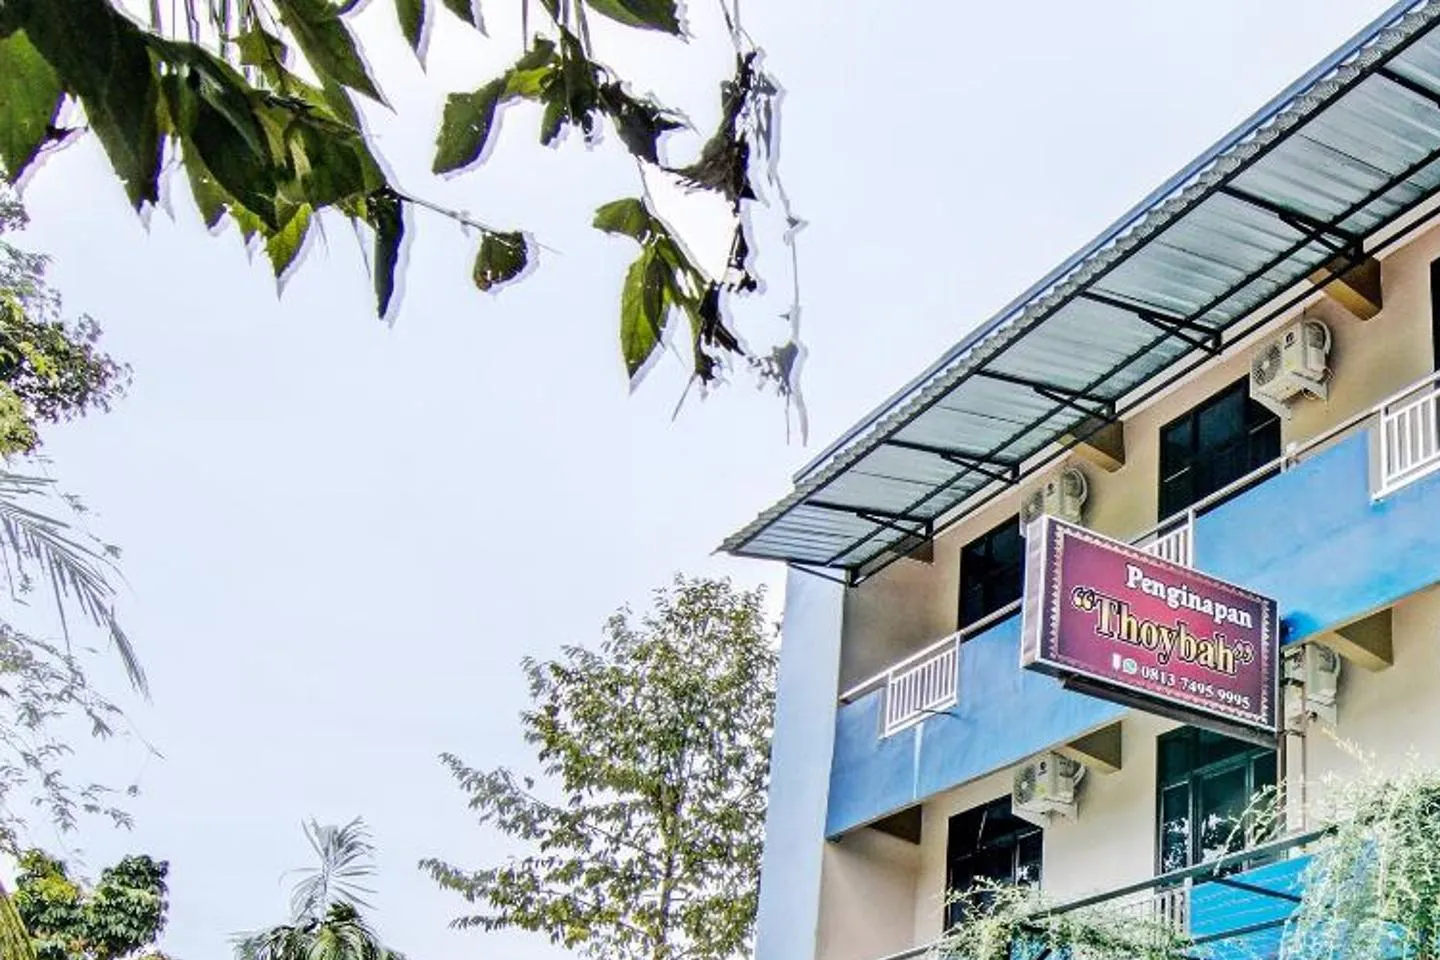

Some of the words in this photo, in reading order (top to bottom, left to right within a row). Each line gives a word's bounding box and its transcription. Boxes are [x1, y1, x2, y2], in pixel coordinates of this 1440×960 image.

[1126, 563, 1253, 629] Penginapan
[1141, 665, 1176, 686] 0813
[1179, 677, 1214, 697] 7495
[1216, 688, 1251, 710] 9995
